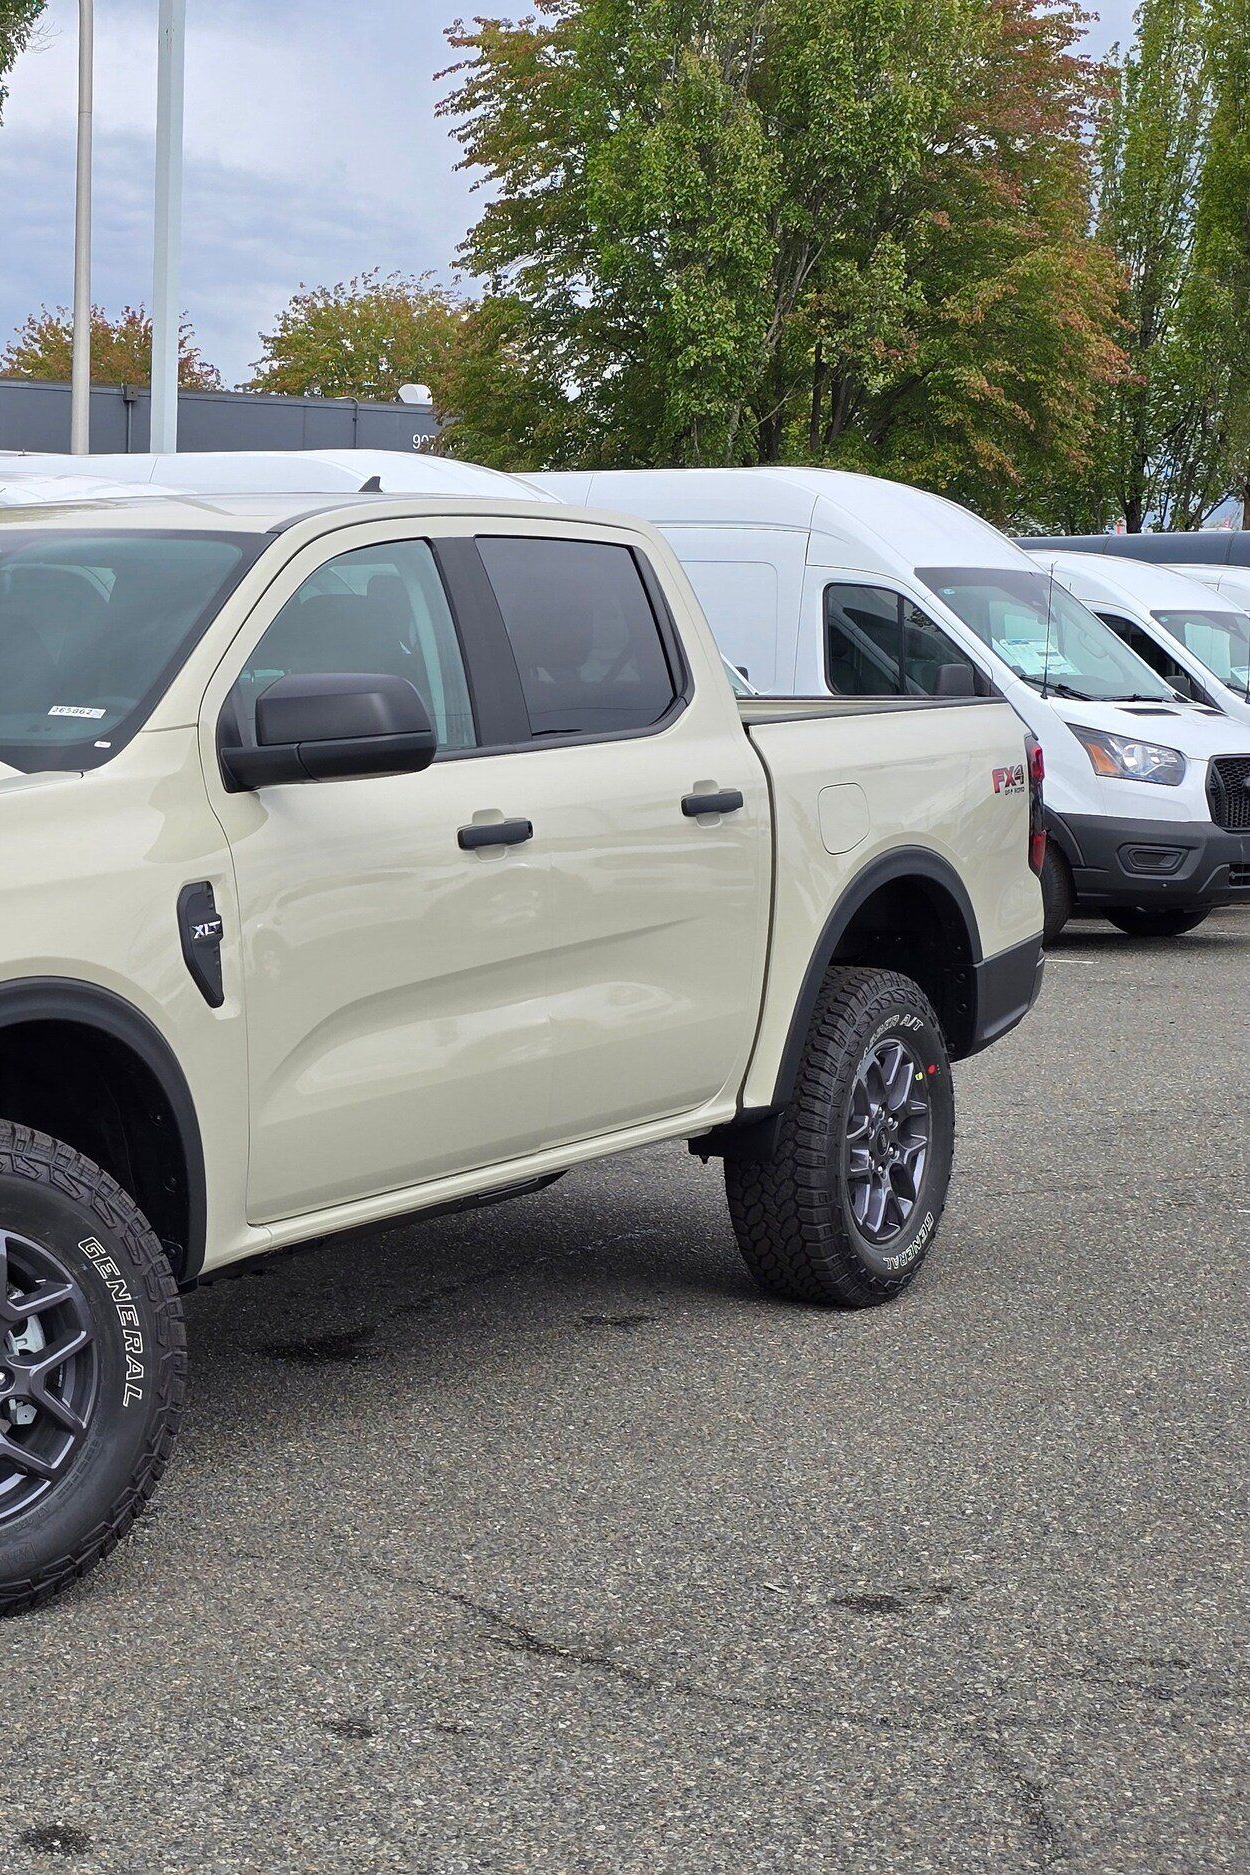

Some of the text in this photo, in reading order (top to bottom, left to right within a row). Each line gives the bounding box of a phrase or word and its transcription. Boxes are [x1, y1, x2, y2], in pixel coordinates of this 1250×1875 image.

[991, 764, 1025, 794] FX4
[192, 920, 221, 939] XLT
[899, 1013, 924, 1032] A/T
[882, 1211, 935, 1270] GENERAL
[77, 1236, 145, 1408] GENERAL
